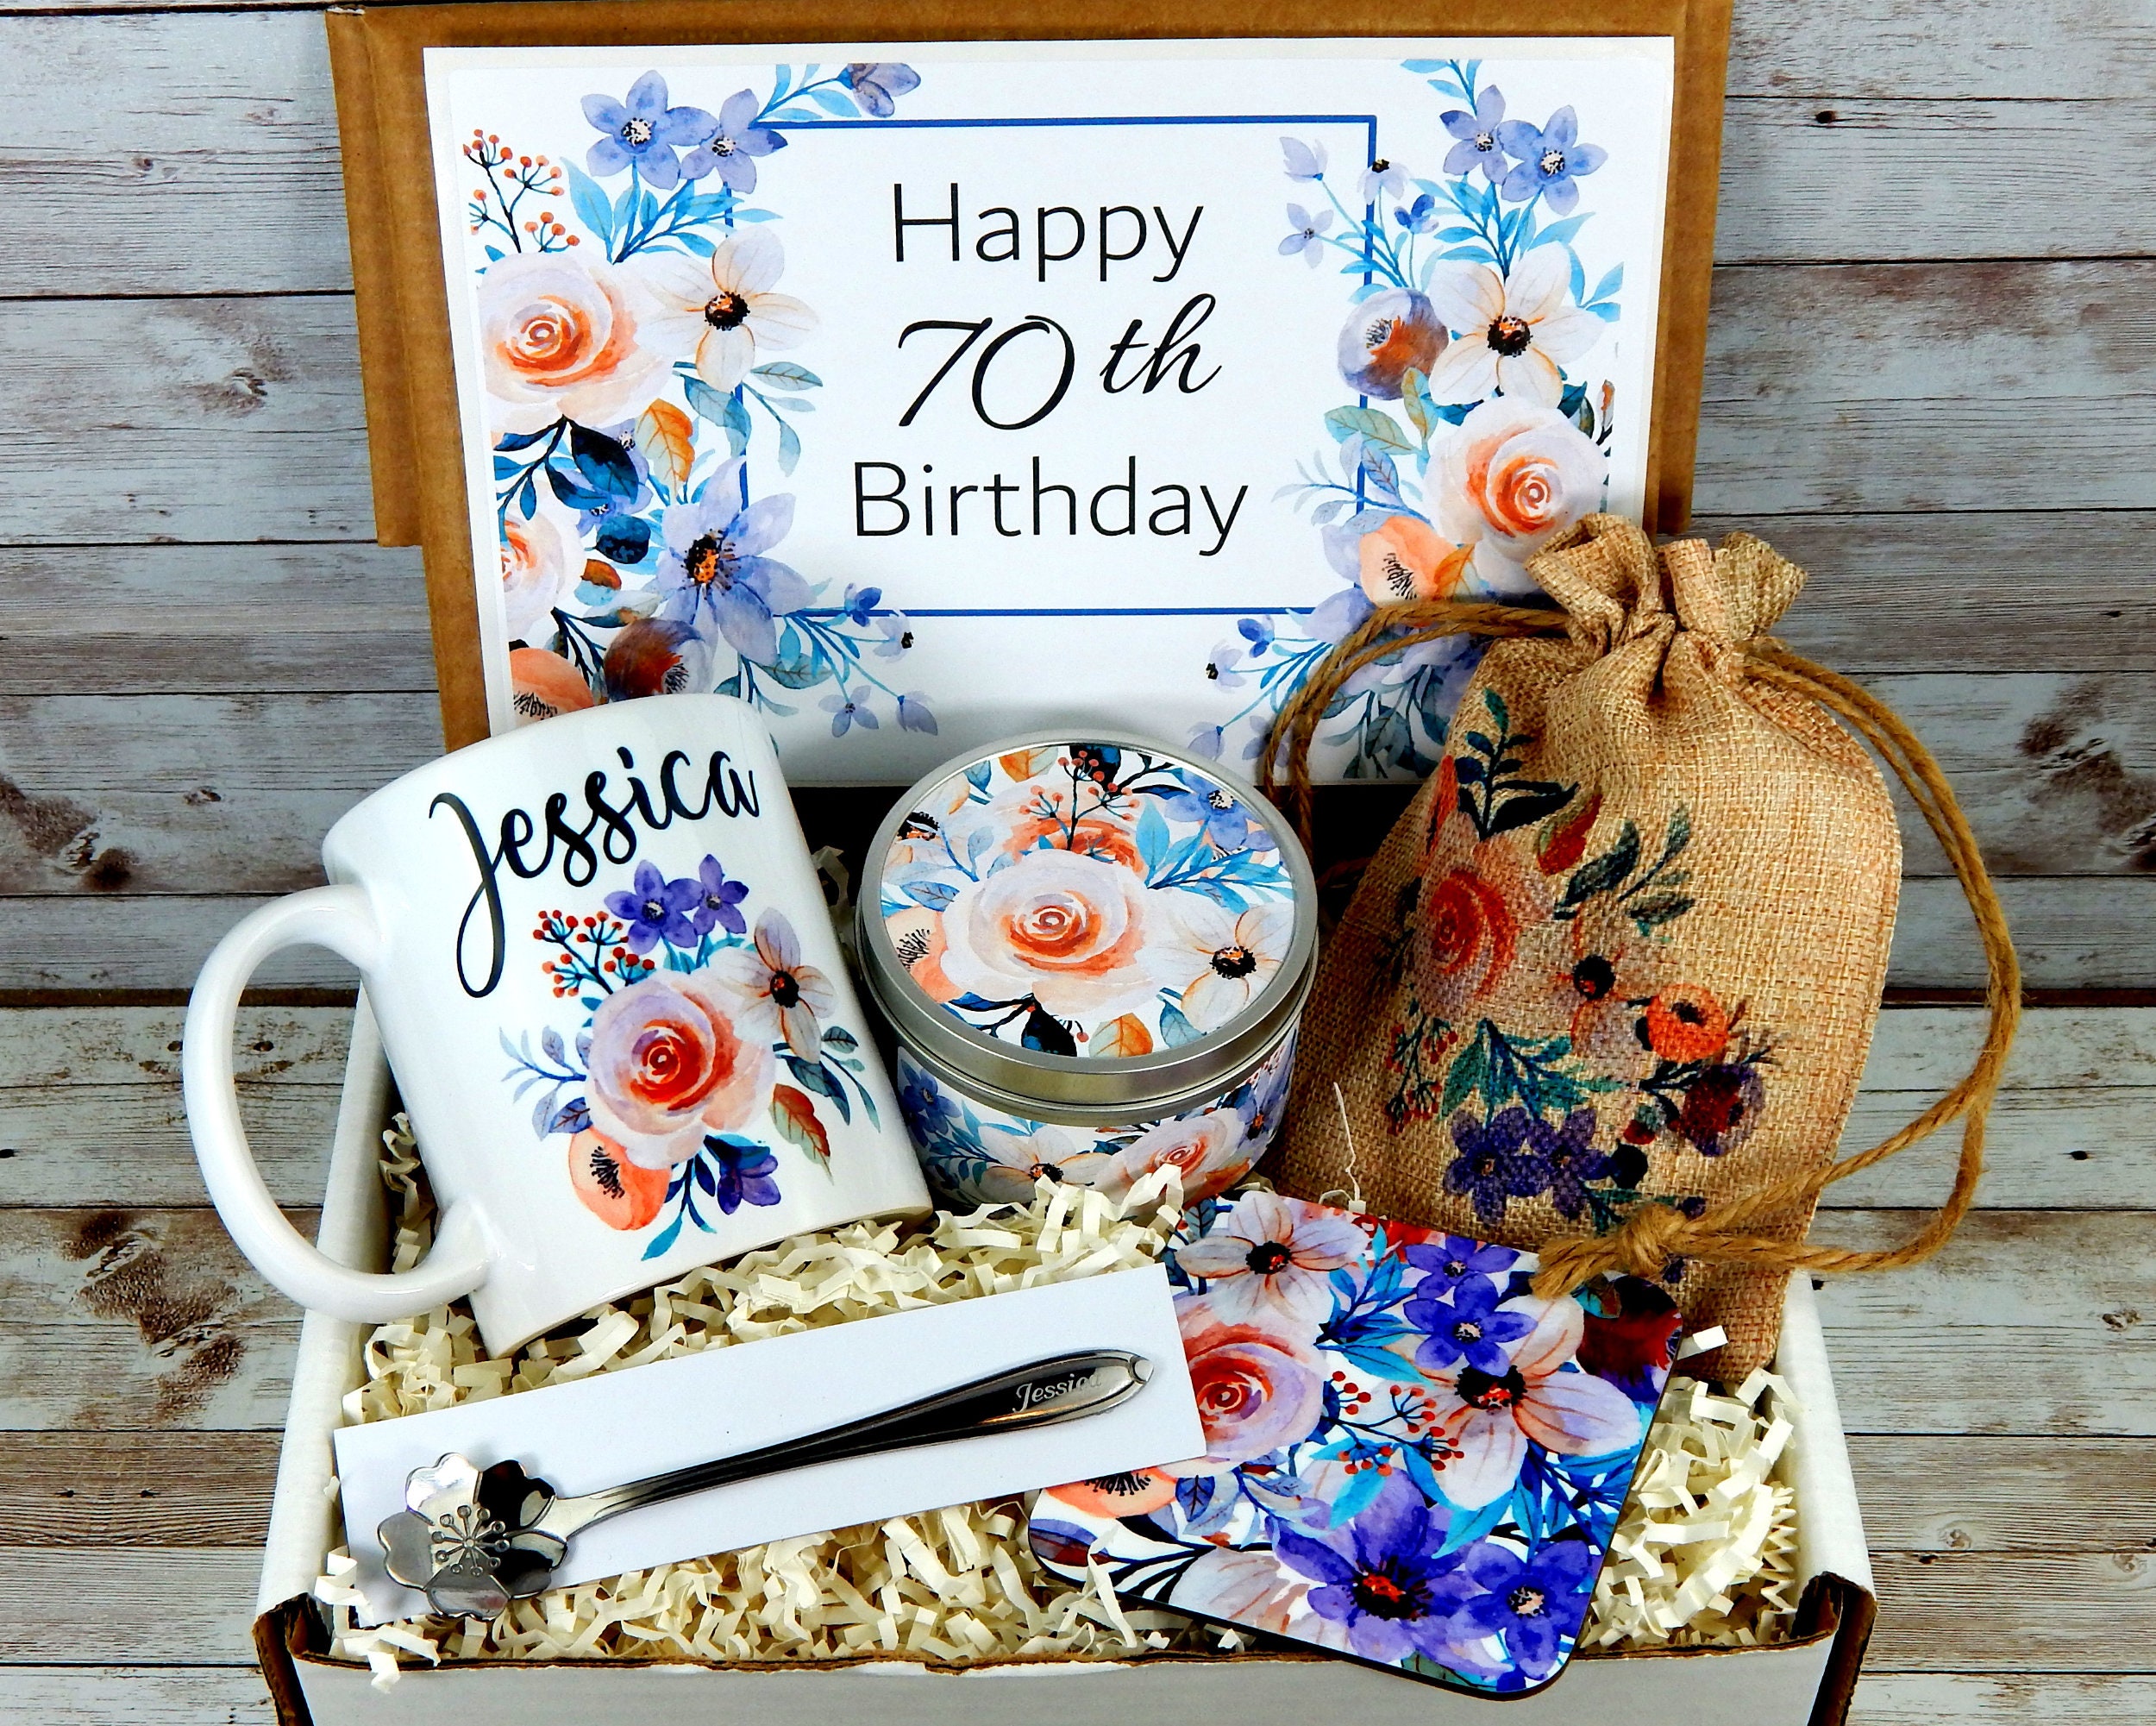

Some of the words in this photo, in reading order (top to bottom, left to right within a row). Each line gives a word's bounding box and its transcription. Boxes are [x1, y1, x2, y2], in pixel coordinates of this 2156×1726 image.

[894, 183, 1203, 282] Happy
[855, 456, 1248, 556] Birthday
[429, 746, 759, 998] Jessica
